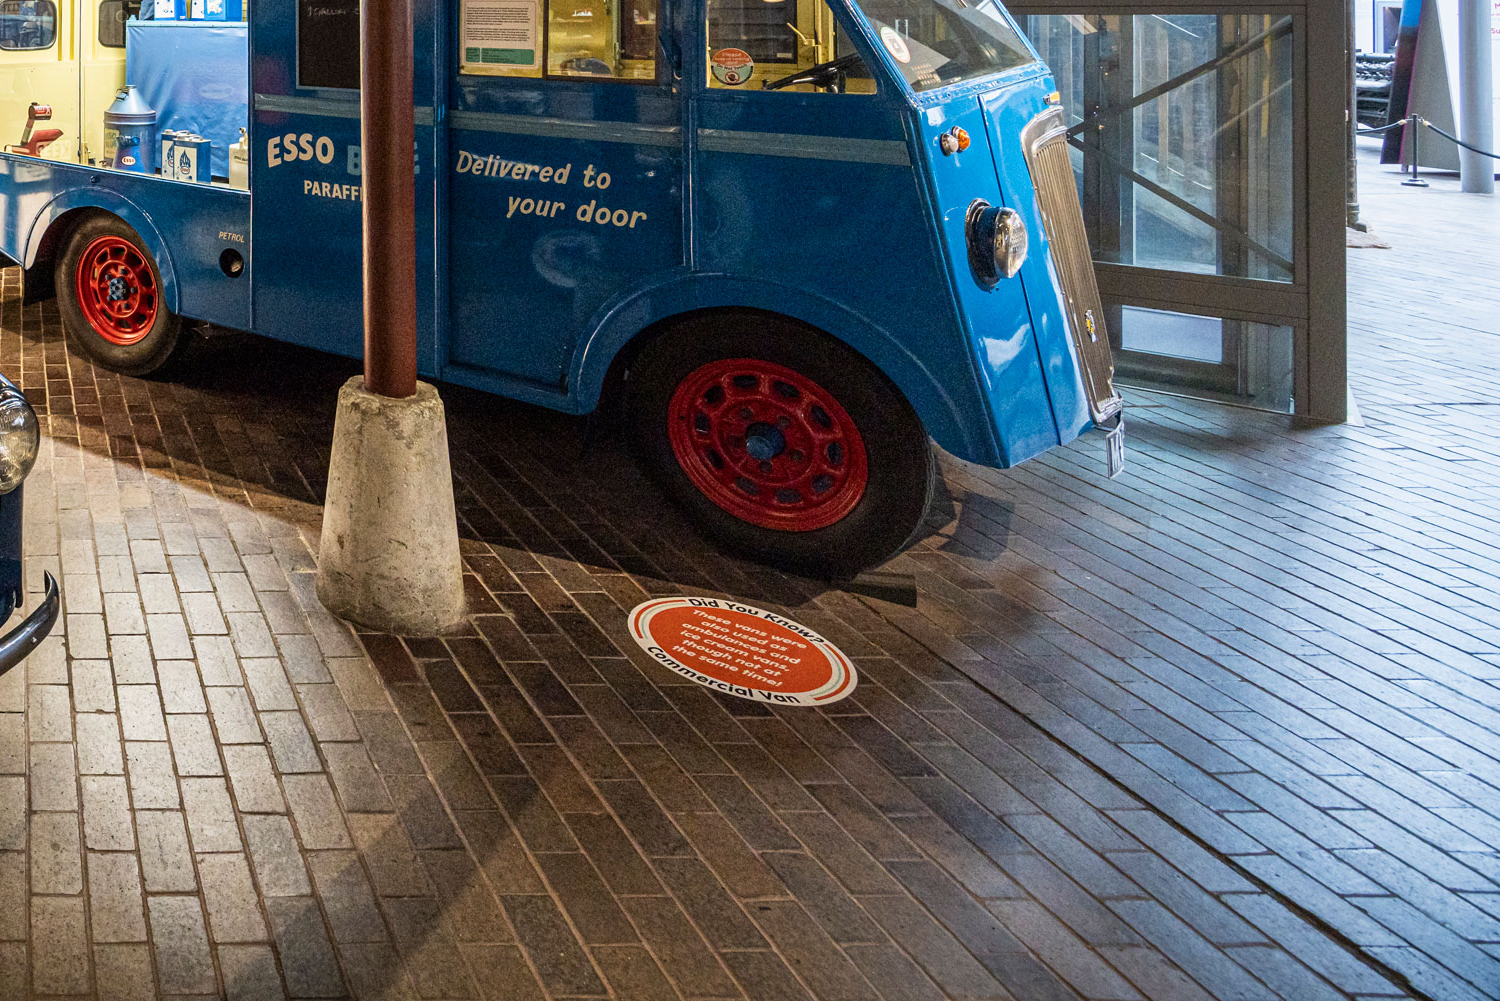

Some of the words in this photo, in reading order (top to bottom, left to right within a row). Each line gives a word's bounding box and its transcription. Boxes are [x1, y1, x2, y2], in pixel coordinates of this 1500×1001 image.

[267, 133, 335, 168] ESSO
[455, 150, 572, 185] Delivered
[583, 164, 611, 189] to
[506, 196, 566, 219] your
[576, 200, 647, 229] door
[218, 231, 245, 244] PETROL
[688, 598, 720, 609] Did
[725, 602, 759, 616] You
[763, 613, 826, 645] Know?
[692, 609, 732, 626] These
[735, 623, 768, 637] vans
[771, 634, 808, 650] were
[701, 619, 730, 634] also
[732, 630, 769, 646] used
[771, 640, 788, 652] as
[680, 630, 701, 642] ice
[703, 637, 750, 658] cream
[753, 652, 790, 673] vans,
[681, 639, 732, 661] though
[735, 655, 762, 670] not
[763, 666, 782, 678] at
[682, 622, 768, 656] ambulances
[770, 650, 801, 665] and
[647, 646, 754, 699] Commercial
[758, 690, 801, 704] Van
[672, 645, 695, 657] the
[698, 654, 739, 673] same
[742, 669, 784, 688] time!
